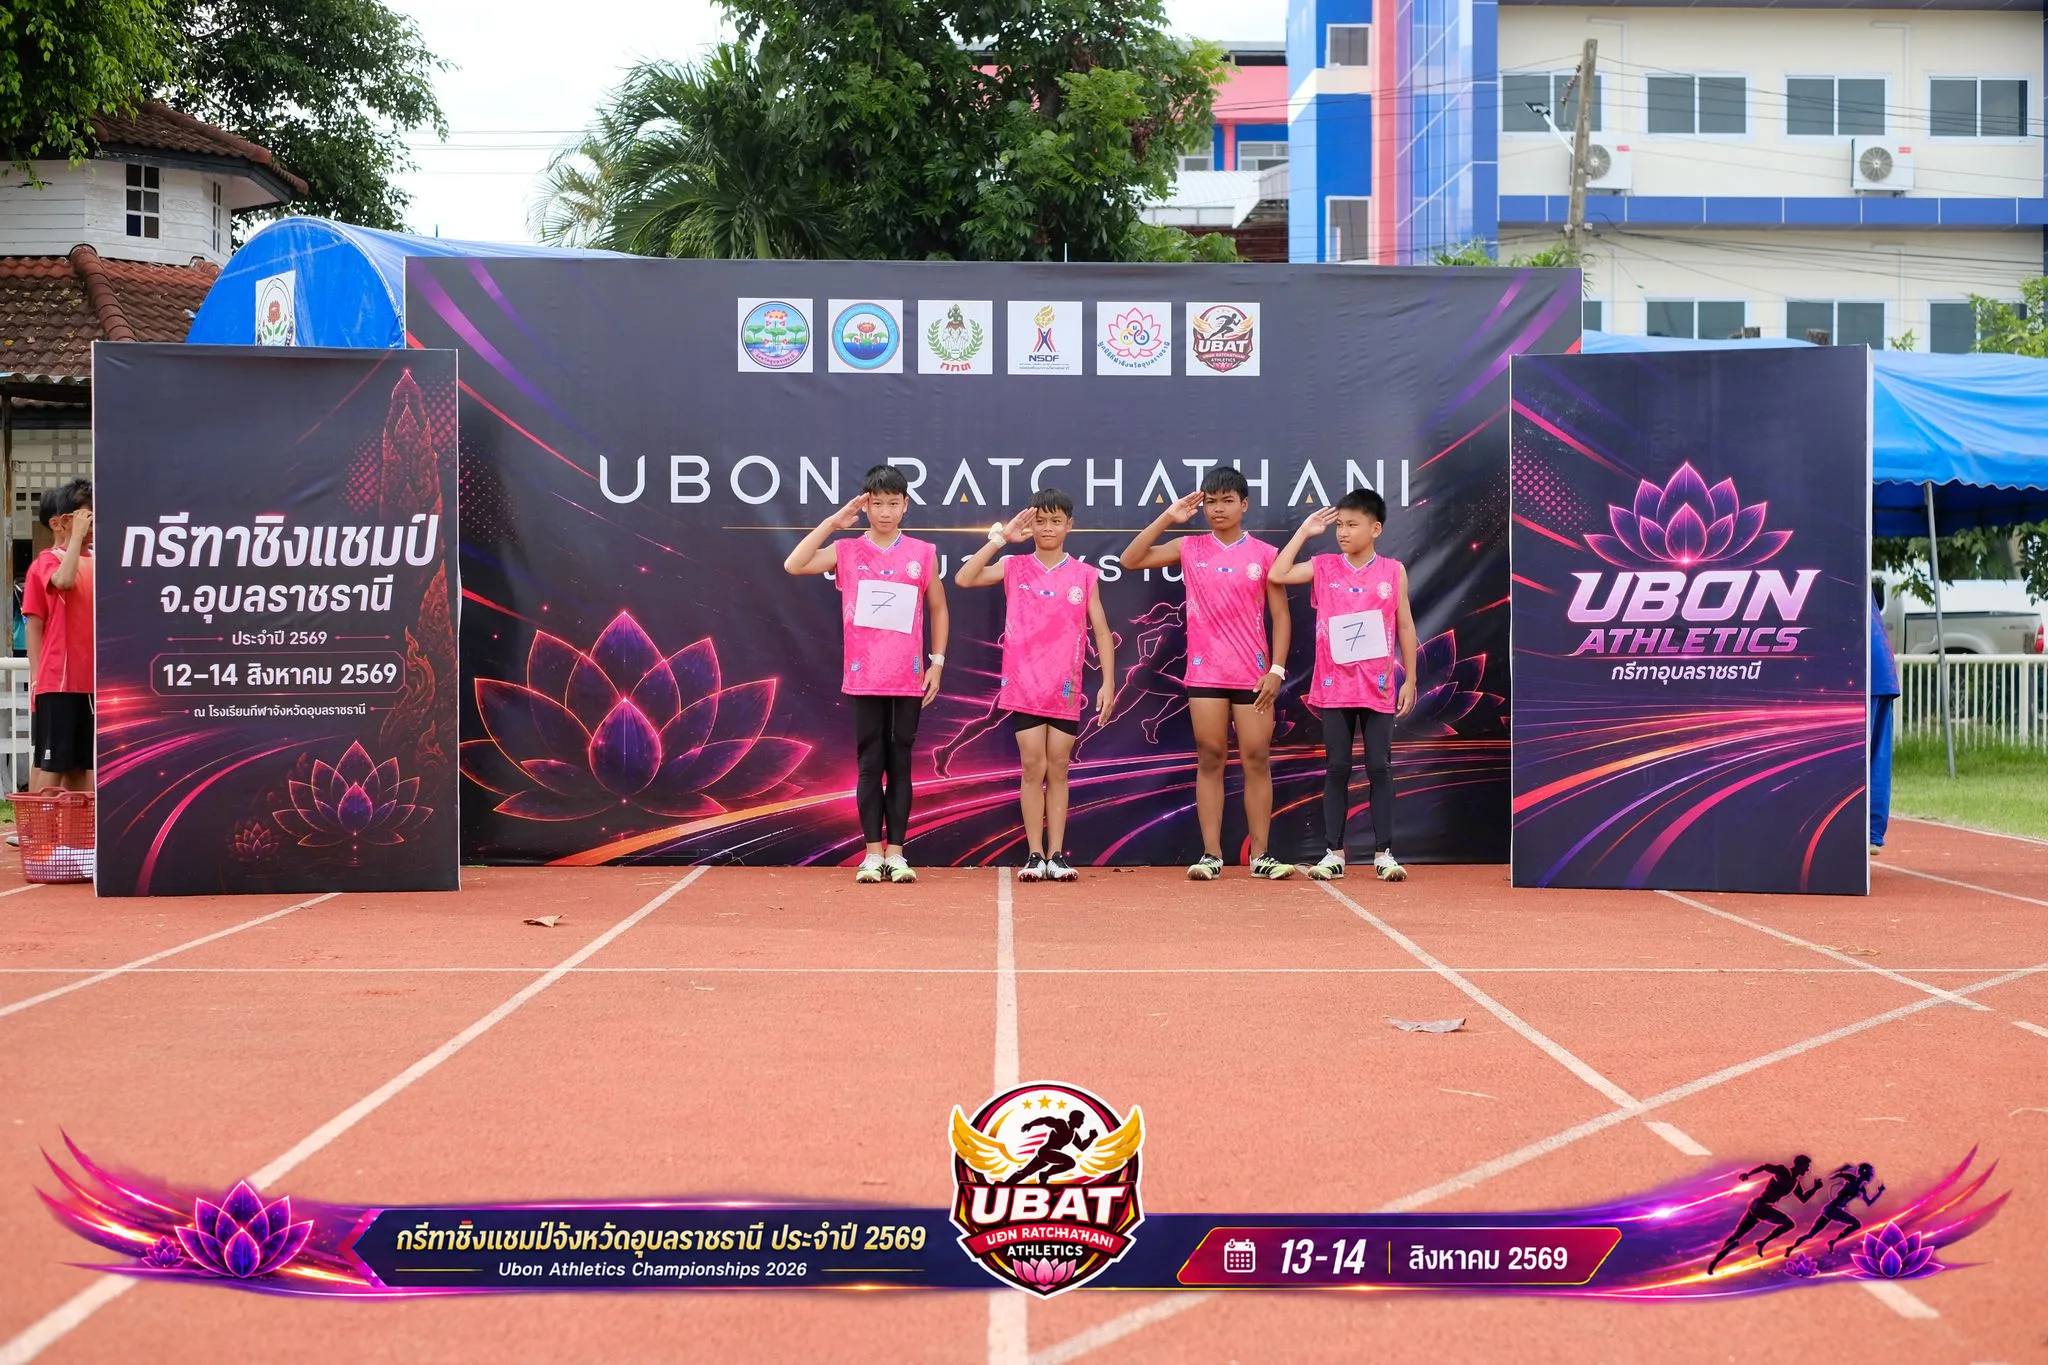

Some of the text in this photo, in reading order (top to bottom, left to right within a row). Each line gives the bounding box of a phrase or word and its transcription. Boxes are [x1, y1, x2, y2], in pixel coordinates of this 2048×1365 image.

[1028, 354, 1060, 362] NSDF
[1198, 340, 1249, 353] UBAT
[600, 454, 840, 505] UBON
[121, 511, 440, 568] กรีฑาชิงแชมป์
[160, 574, 395, 624] จ.อุบลราชธานี
[871, 590, 897, 615] 7
[1567, 569, 1822, 623] UBON
[232, 629, 328, 646] ประจำปี 2569
[1342, 621, 1366, 652] 7
[1565, 627, 1812, 656] ATHLETICS
[247, 663, 332, 686] สิงหาคม
[340, 663, 397, 685] 2569
[1611, 660, 1762, 686] กรีฑาอุบลราชธานี
[194, 703, 366, 720] ณ โรงเรียนกีฬาจังหวัดอุบลราชธานี
